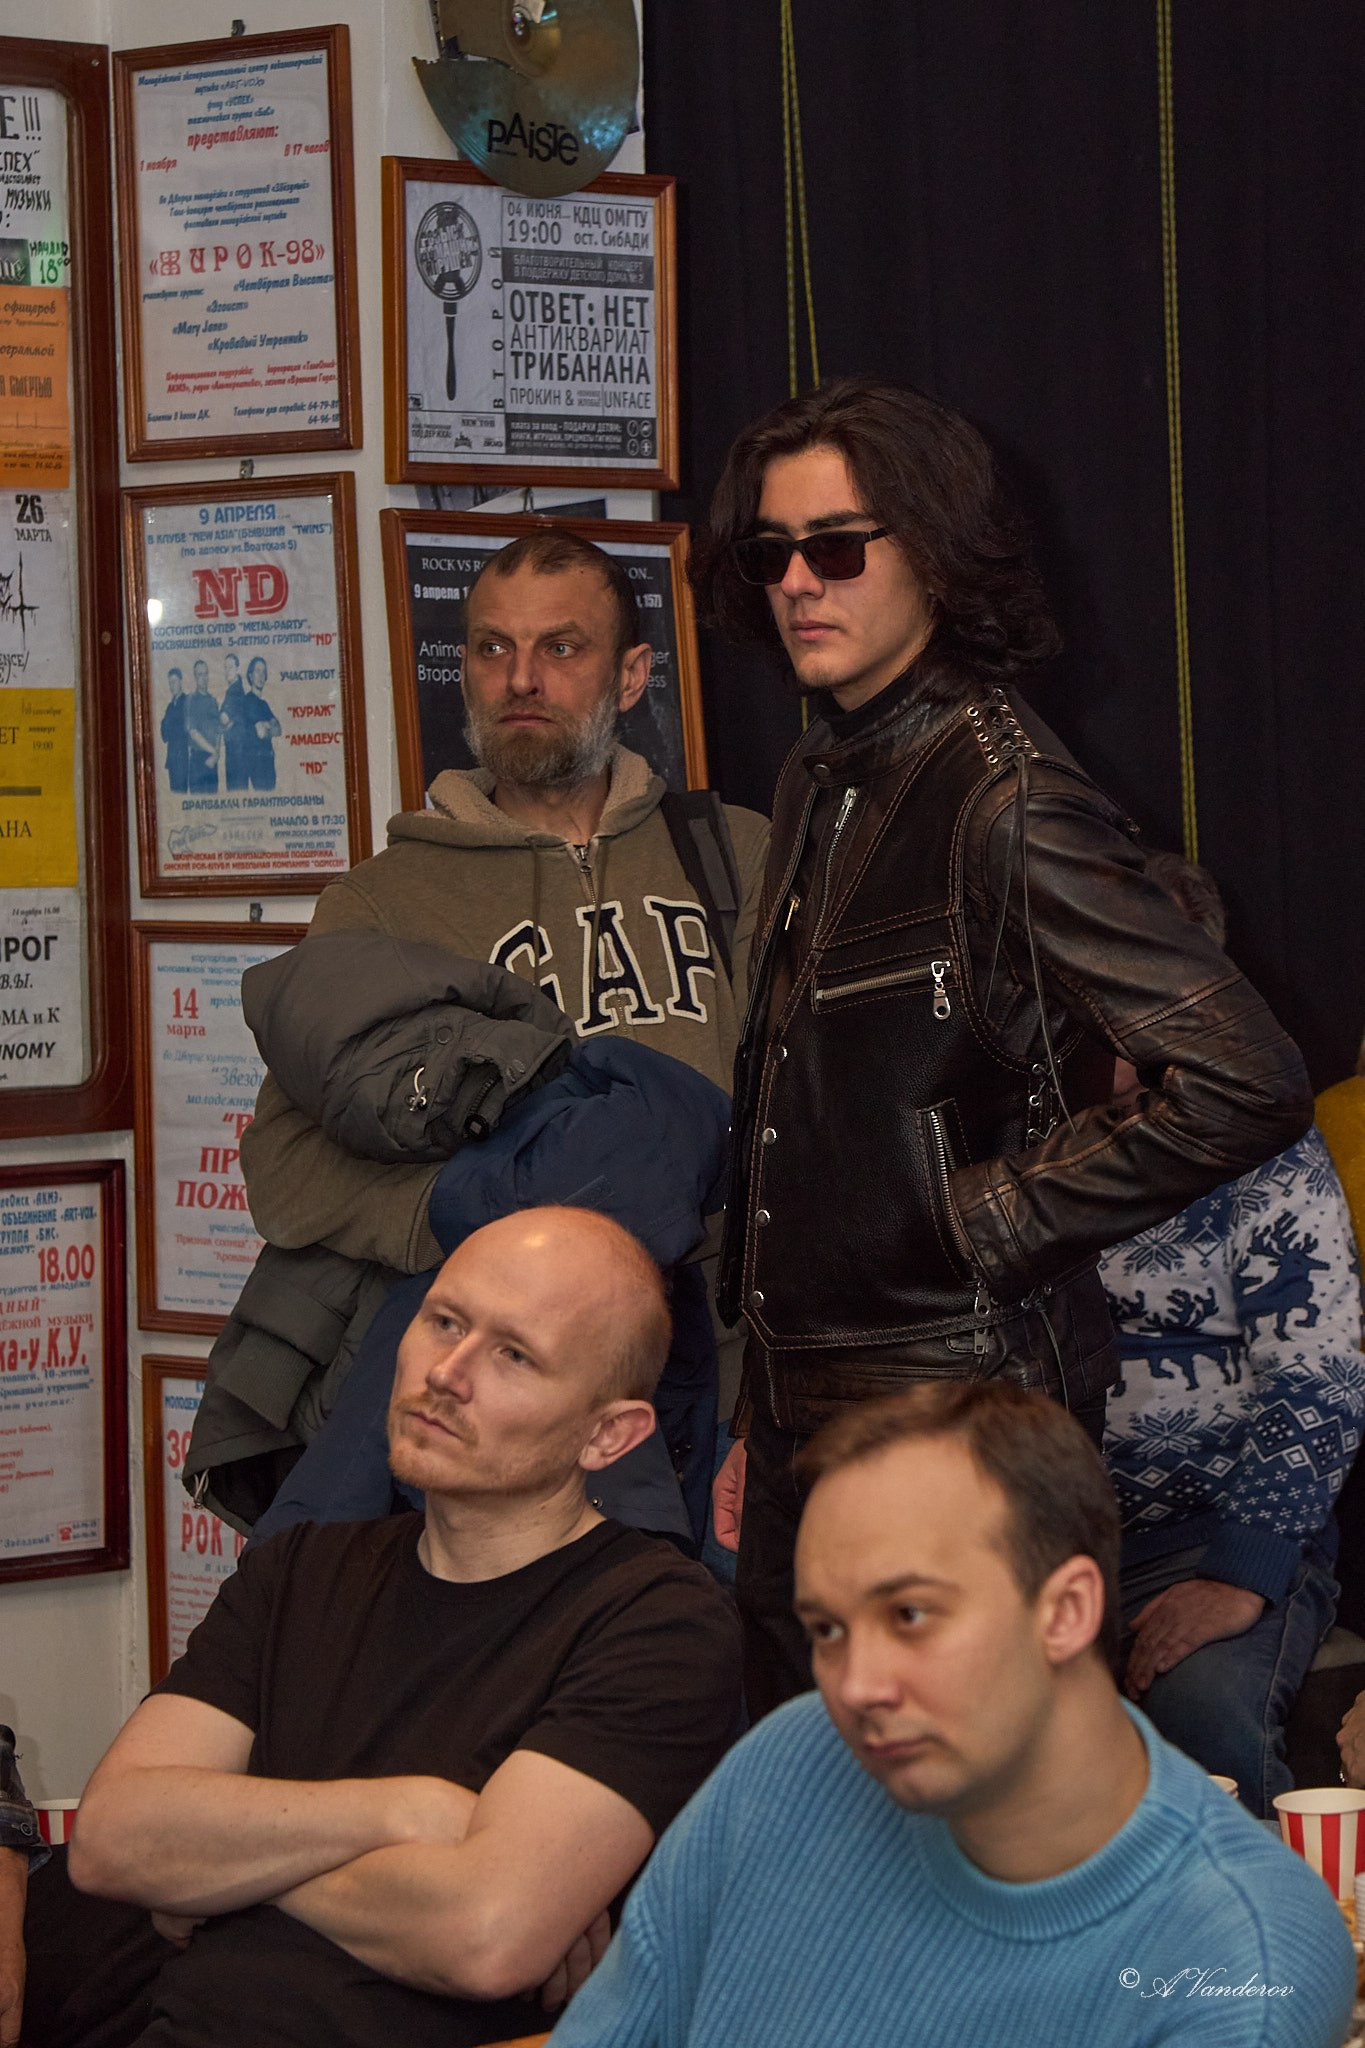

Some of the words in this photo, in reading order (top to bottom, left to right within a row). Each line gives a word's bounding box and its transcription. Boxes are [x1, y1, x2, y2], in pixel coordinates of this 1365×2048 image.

[186, 125, 280, 152] представляют:
[292, 142, 302, 156] 17
[507, 201, 523, 218] 04
[526, 203, 563, 220] ИЮНЯ
[573, 204, 603, 229] КДЦ
[605, 206, 648, 231] ОМГТУ
[507, 218, 562, 245] 19:00
[574, 232, 599, 245] ост.
[601, 229, 649, 253] СибАДИ
[603, 294, 651, 329] НЕТ
[510, 323, 651, 355] АНТИКВАРИАТ
[509, 350, 652, 386] ТРИБАНАНА
[509, 387, 562, 407] ПРОКИН
[565, 391, 575, 407] &
[603, 391, 652, 410] UNFACE
[15, 494, 45, 524] 26
[199, 507, 209, 525] 9
[214, 502, 276, 524] АПРЕЛЯ
[15, 527, 53, 543] МАРТА
[421, 557, 456, 572] ROCK
[456, 558, 472, 573] VS
[191, 563, 290, 621] ND
[413, 583, 421, 599] 9
[206, 621, 237, 634] СУПЕР
[280, 667, 336, 682] УЧАСТВУЮТ
[287, 704, 336, 719] "КУРАЖ"
[299, 760, 329, 775] "ND"
[242, 794, 325, 809] ГАРАНТИРОВАНЫ
[270, 815, 309, 828] НАЧАЛО
[0, 935, 59, 963] РОГ
[488, 895, 717, 1038] GAP
[172, 986, 200, 1020] 14
[166, 1023, 207, 1041] марта
[0, 1041, 57, 1061] NOMY
[38, 1243, 96, 1284] 18.00
[180, 1512, 223, 1558] РОК
